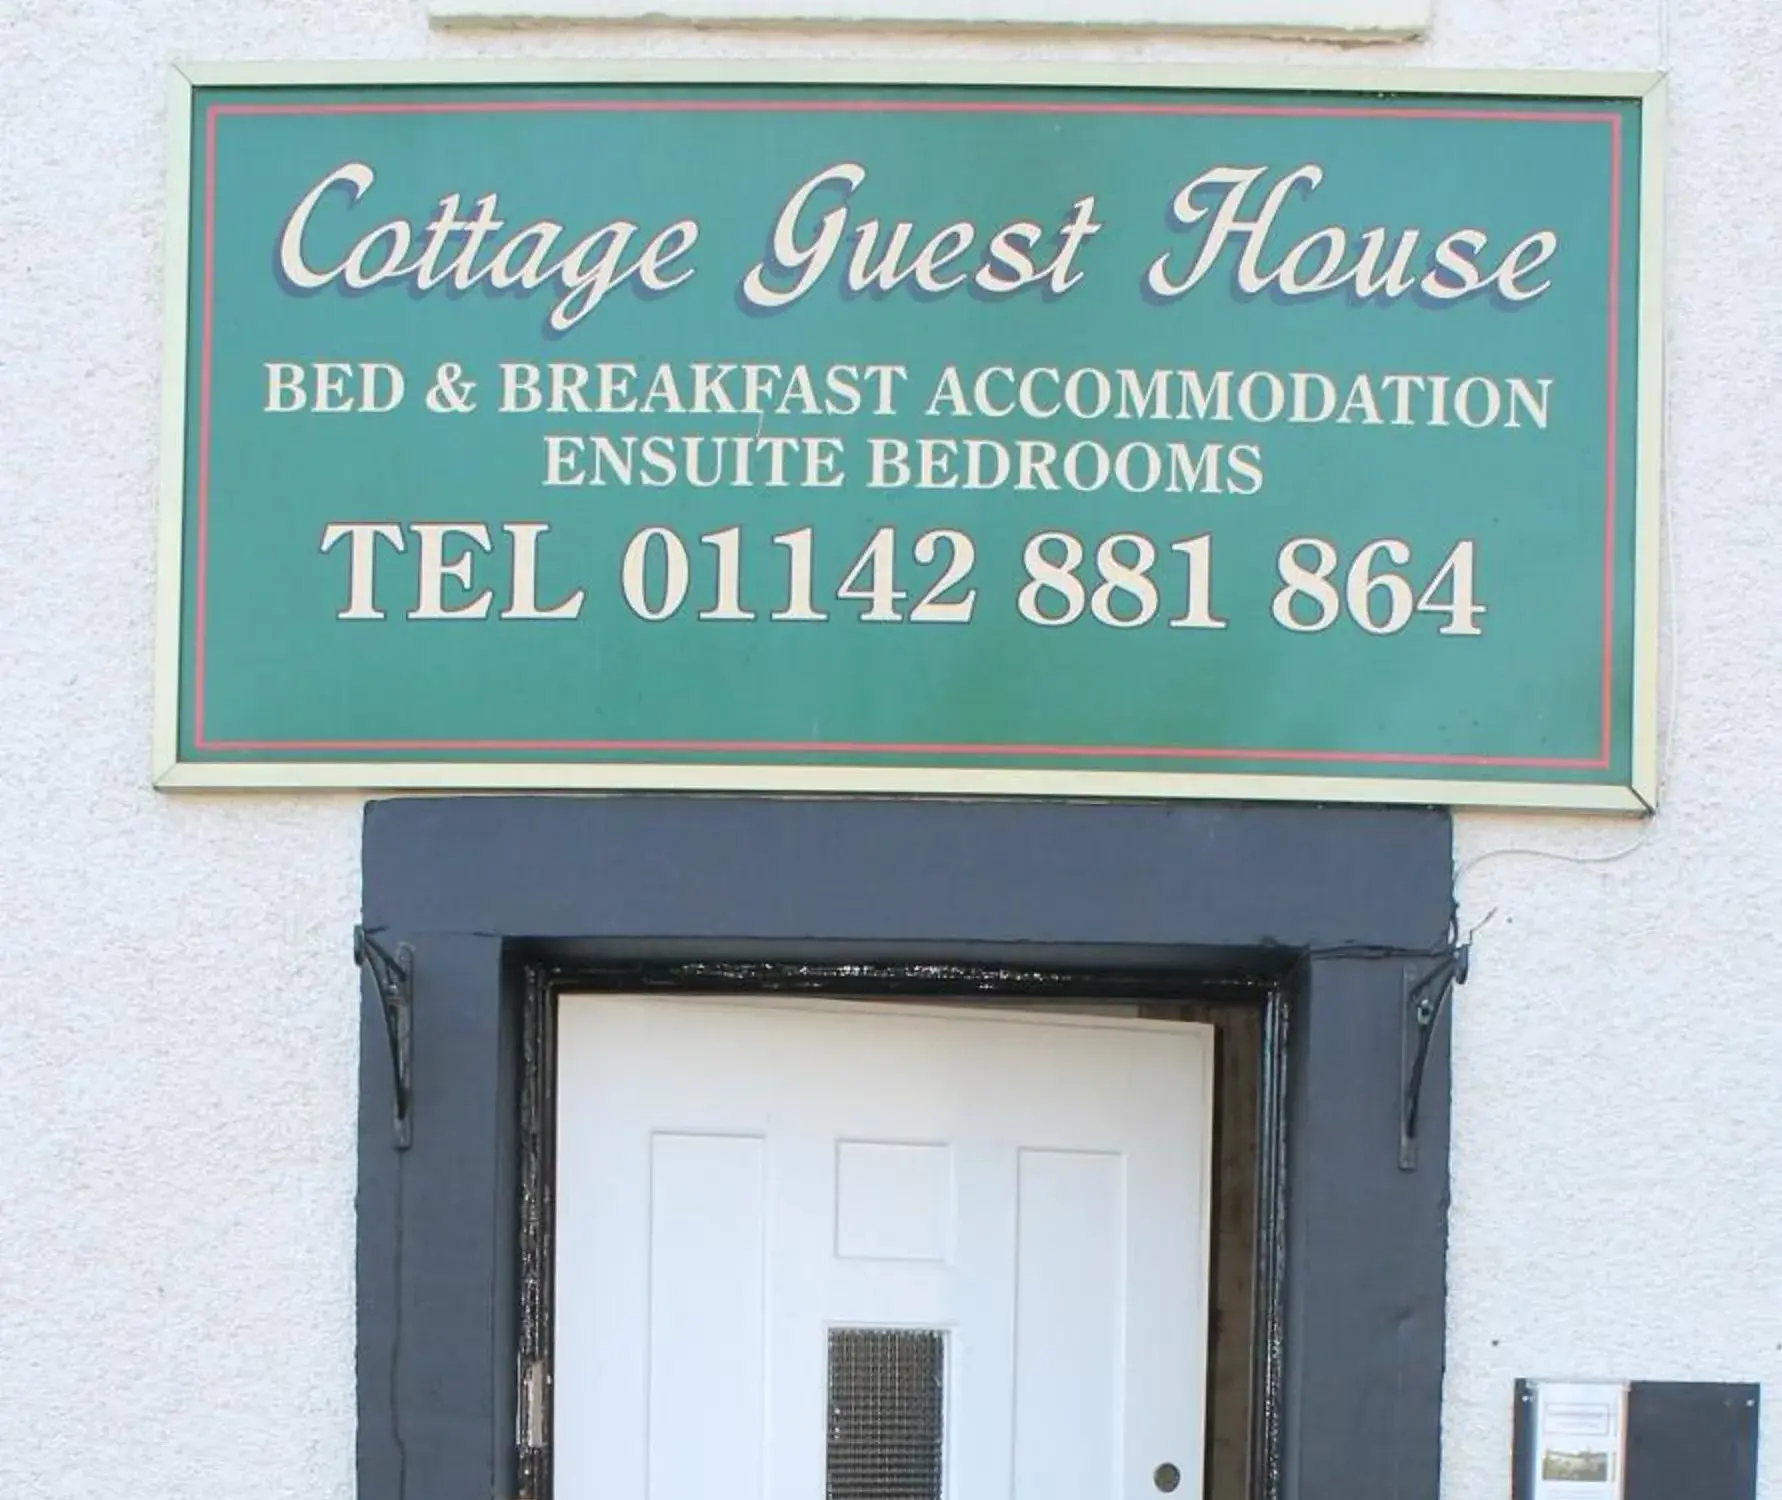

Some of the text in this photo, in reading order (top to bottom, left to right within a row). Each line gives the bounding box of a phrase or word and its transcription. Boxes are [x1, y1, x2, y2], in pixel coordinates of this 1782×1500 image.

[278, 162, 1558, 332] Cottage Guest House
[263, 362, 1553, 428] BED & BREAKFAST ACCOMMODATION
[542, 436, 1263, 495] ENSUITE BEDROOMS
[320, 521, 1487, 636] TEL 01142 881 864
